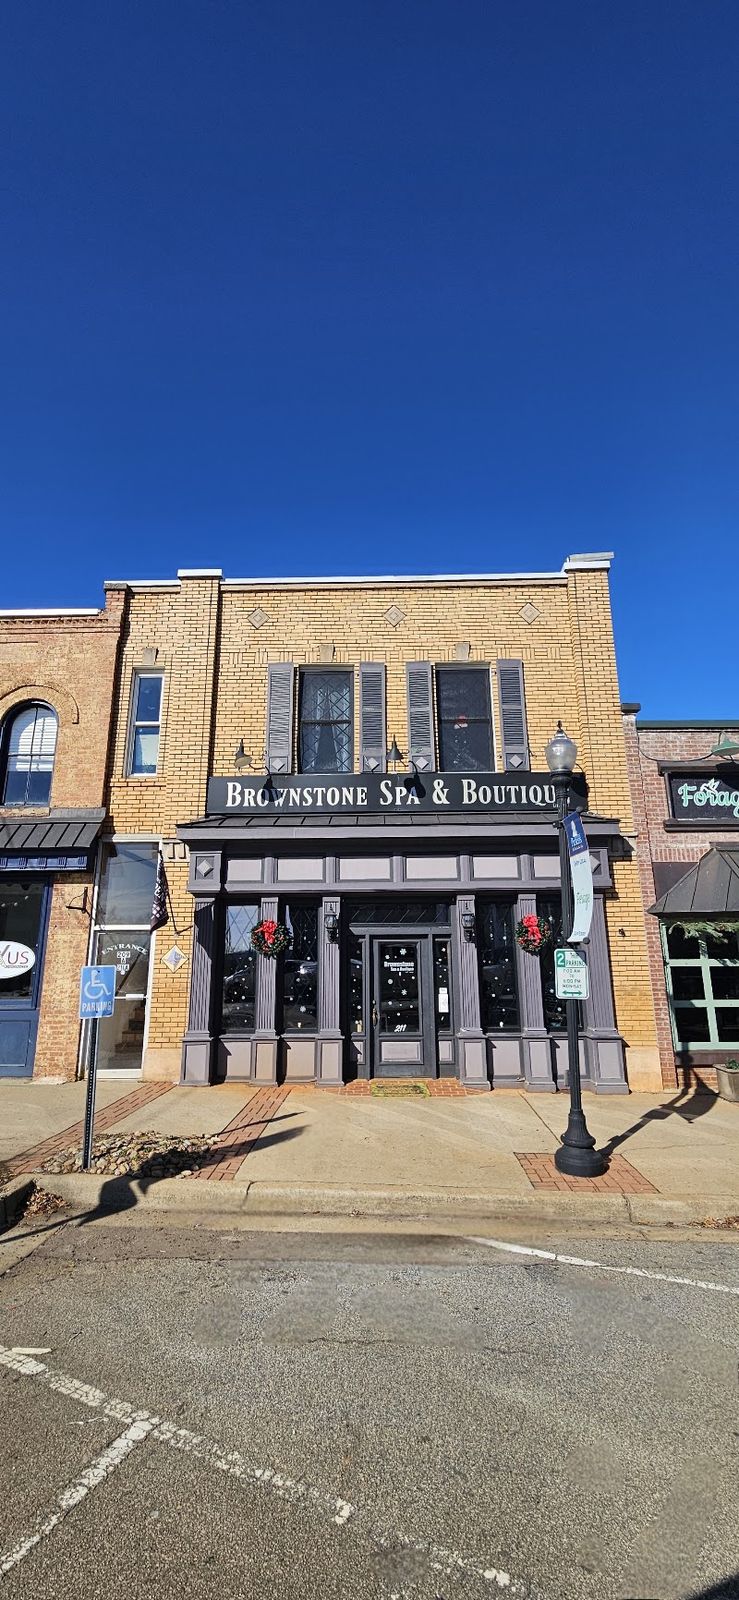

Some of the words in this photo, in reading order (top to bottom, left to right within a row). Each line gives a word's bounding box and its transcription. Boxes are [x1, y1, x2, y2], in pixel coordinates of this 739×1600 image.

[225, 781, 367, 807] BROWNSTONE
[379, 779, 421, 806] SPA
[432, 778, 450, 805] &
[461, 779, 570, 807] BOUTIQU
[101, 943, 148, 955] ENTRANCE
[557, 953, 565, 965] 2
[82, 1001, 112, 1013] PARKING
[394, 1024, 407, 1032] 211
